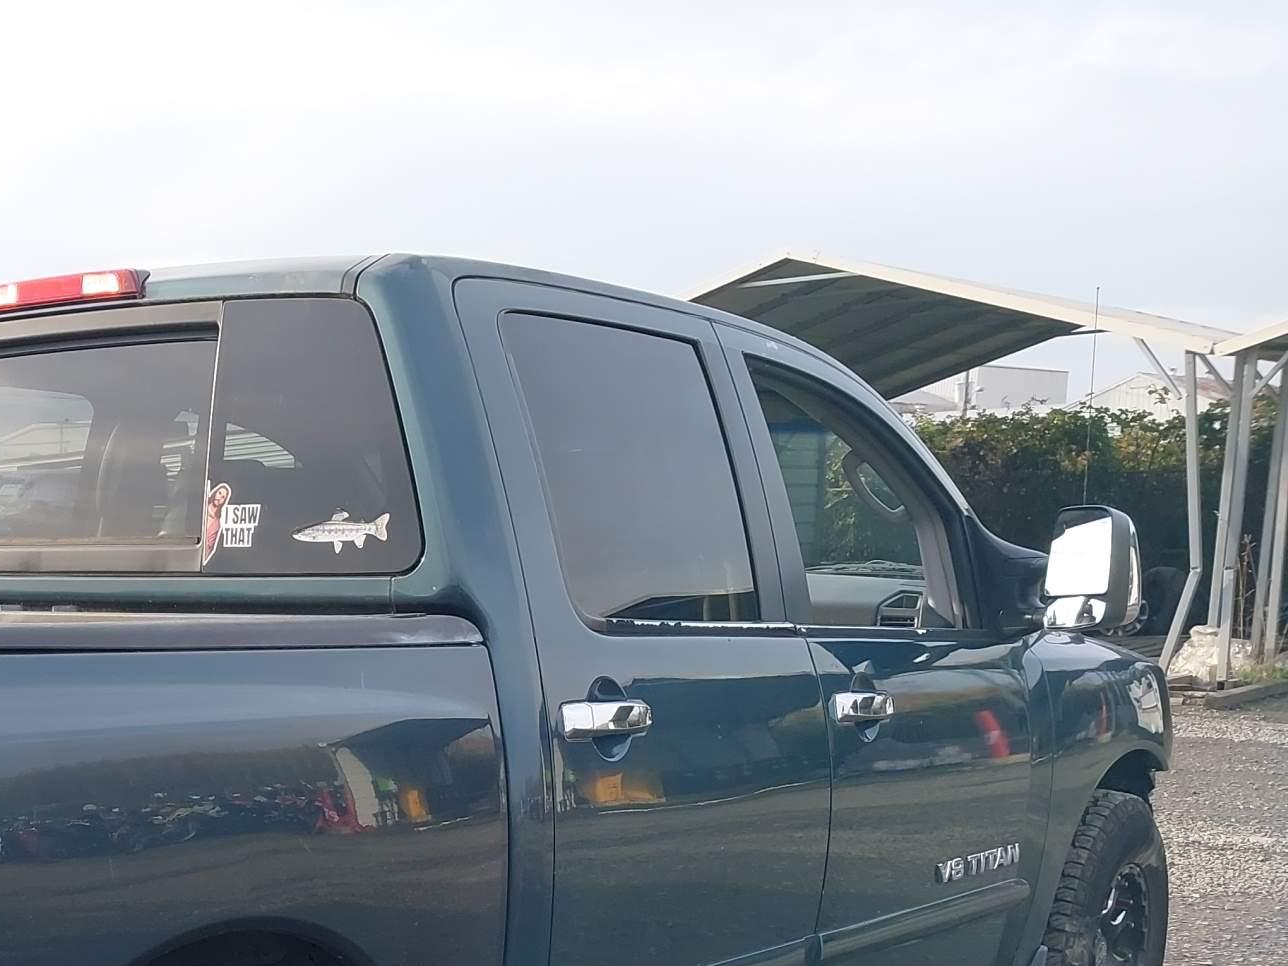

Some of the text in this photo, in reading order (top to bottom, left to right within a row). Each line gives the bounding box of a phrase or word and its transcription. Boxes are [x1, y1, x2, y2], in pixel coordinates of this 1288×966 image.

[232, 506, 259, 525] SAW
[224, 527, 252, 546] THAT
[936, 843, 1020, 883] V8 TITAN
